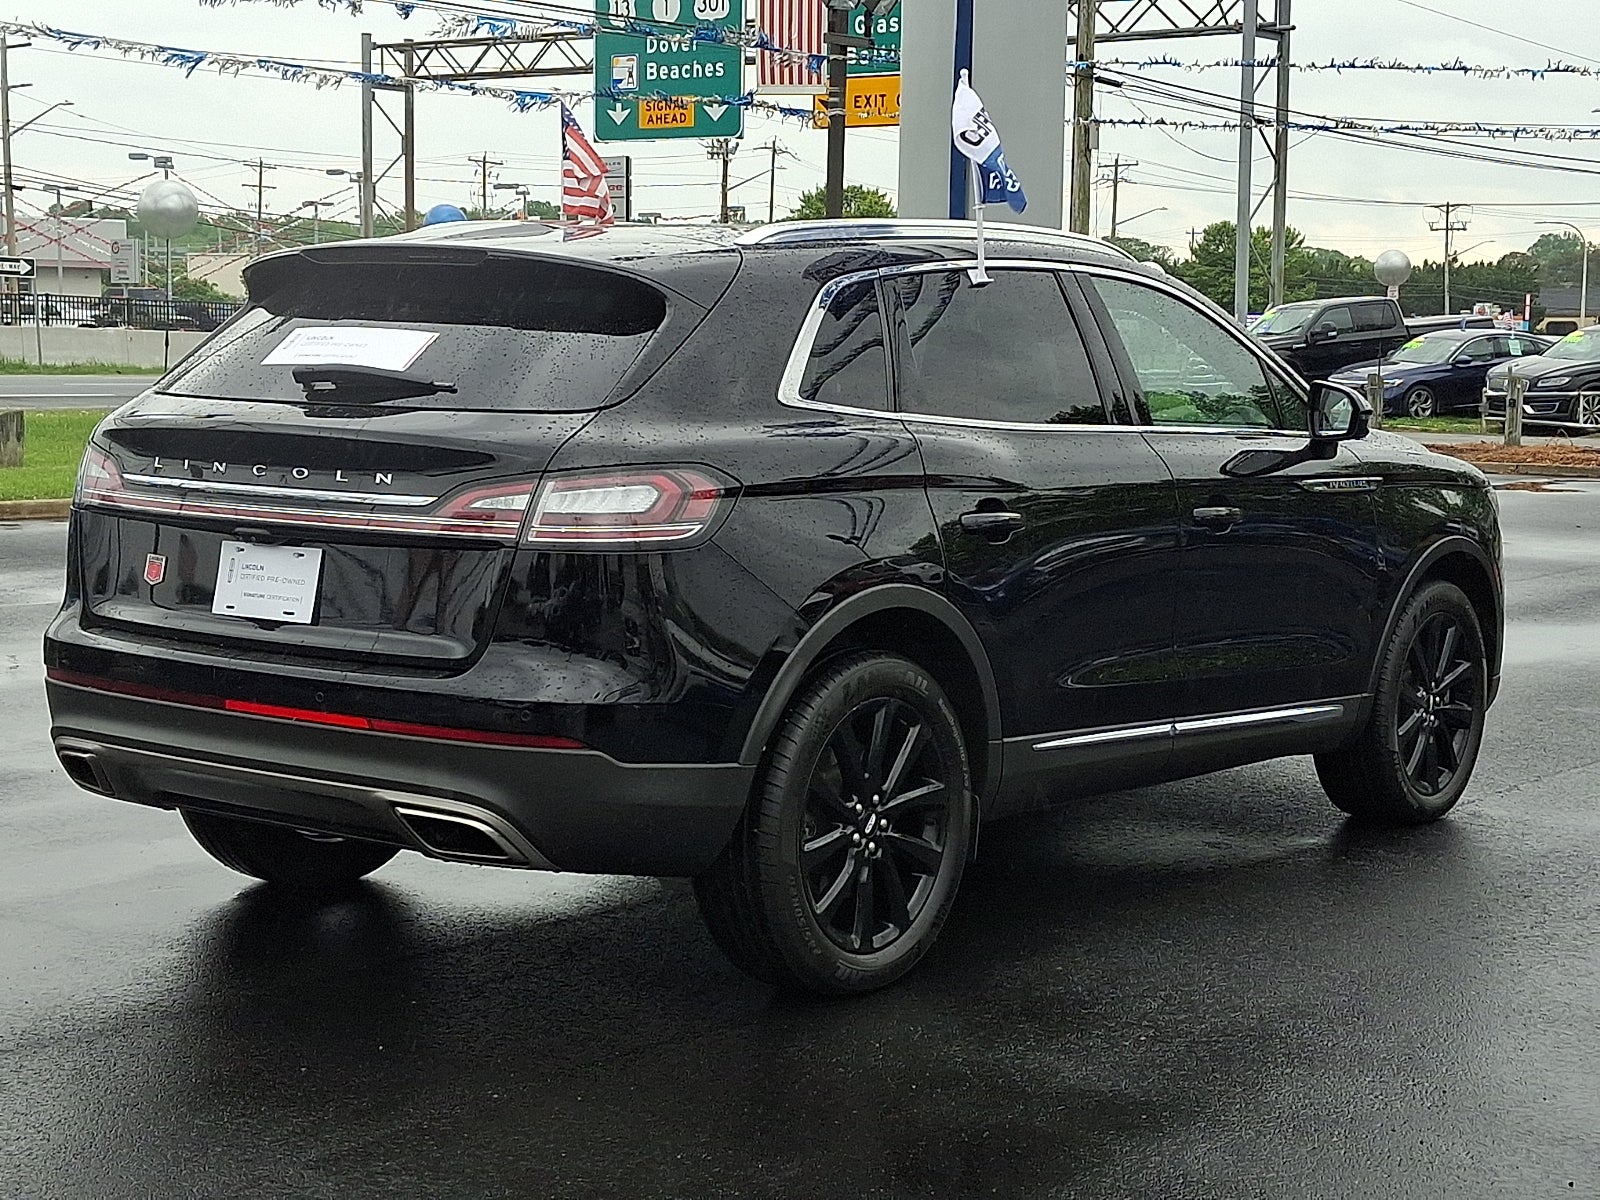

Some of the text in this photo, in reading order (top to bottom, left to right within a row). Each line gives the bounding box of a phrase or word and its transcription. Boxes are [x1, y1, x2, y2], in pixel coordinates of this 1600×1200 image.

[646, 35, 698, 54] Dover
[646, 60, 725, 80] Beaches
[853, 94, 887, 109] EXIT
[647, 112, 687, 125] AHEAD
[154, 456, 393, 485] LINCOLN
[241, 563, 265, 571] LINCOLN
